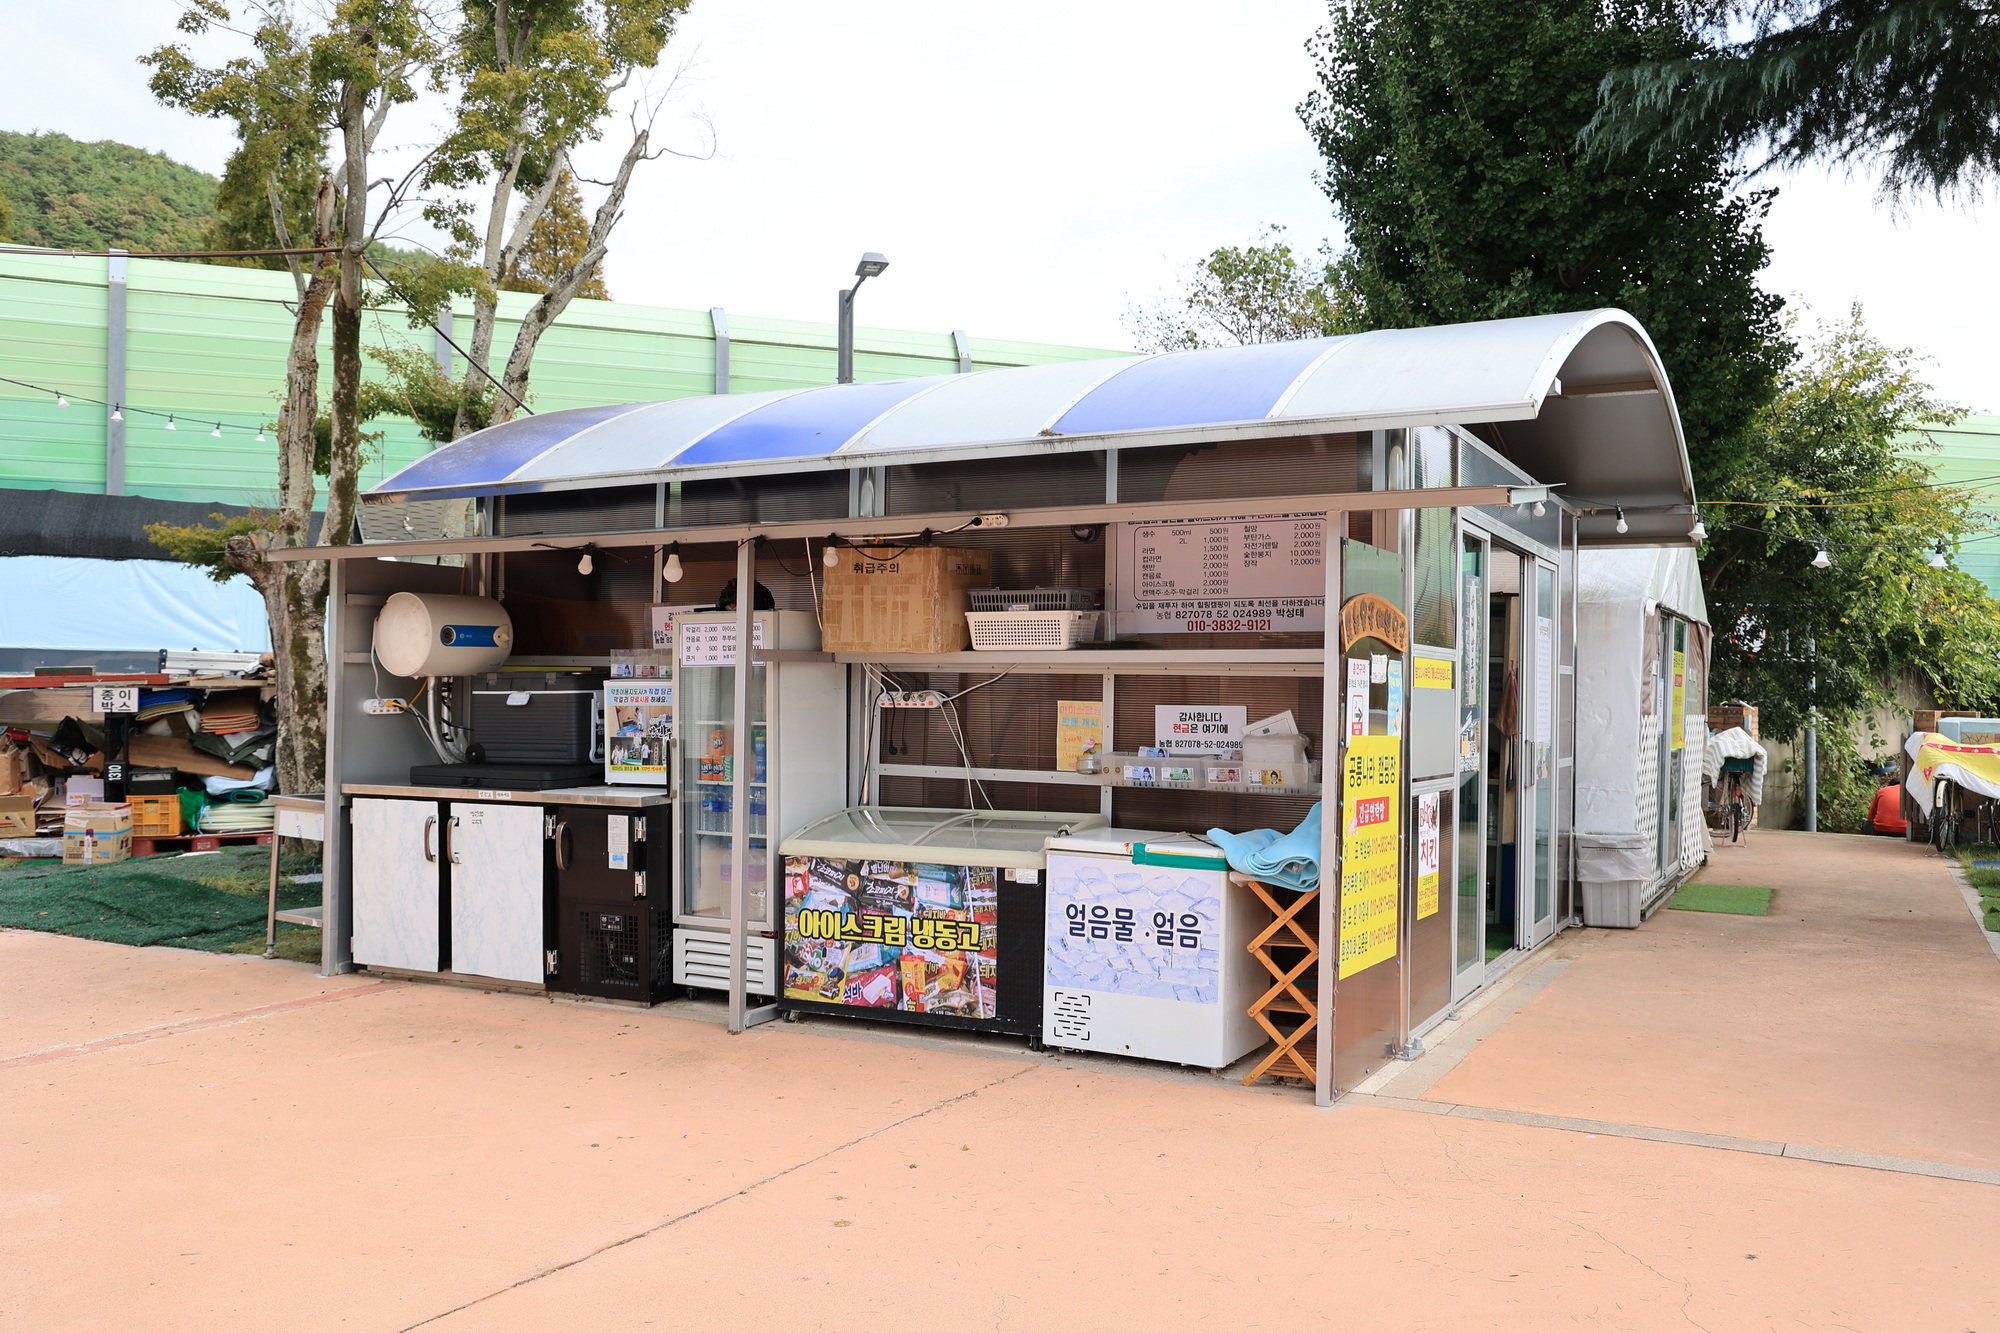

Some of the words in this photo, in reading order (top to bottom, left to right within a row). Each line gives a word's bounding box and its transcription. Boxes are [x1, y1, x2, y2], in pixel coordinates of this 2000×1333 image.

[1142, 530, 1155, 538] 생수
[1209, 527, 1228, 535] 500원
[1294, 523, 1321, 531] 2,000원
[1203, 536, 1228, 544] 1,000원
[1243, 533, 1271, 541] 부탄가스
[1294, 531, 1321, 539] 2,000원
[1294, 540, 1321, 548] 2,000원
[1142, 555, 1162, 563] 컵라면
[1203, 553, 1228, 561] 2,000원
[1290, 549, 1321, 557] 10,000원
[1203, 562, 1228, 570] 2,000원
[1290, 558, 1321, 566] 12,000원
[853, 562, 899, 574] 취급주의
[1142, 580, 1175, 588] 아이스크림
[1203, 579, 1228, 587] 2,000원
[1135, 602, 1155, 610] 수입을
[1181, 601, 1195, 609] 하여
[1197, 601, 1231, 609] 힐링캠핑이
[1234, 600, 1255, 608] 되도록
[1282, 599, 1325, 607] 다하겠습니다
[1156, 611, 1172, 620] 농협
[1175, 610, 1213, 619] 827078
[1216, 610, 1229, 618] 52
[1232, 609, 1272, 618] 024989
[1275, 608, 1305, 618] 박성태
[1187, 619, 1271, 632] 010-3832-9121
[101, 701, 131, 713] 박스
[1060, 705, 1101, 715] 아이스크림
[1178, 712, 1222, 723] 감사합니다
[1173, 723, 1199, 734] 현금은
[1202, 723, 1229, 734] 여기에
[1159, 740, 1173, 748] 농협
[1175, 740, 1243, 748] 827078-52-024989
[108, 765, 122, 781] 1310
[1349, 756, 1375, 787] 공룡나라
[1378, 755, 1396, 784] 캠핑장
[1359, 800, 1386, 824] 긴급연락망
[1421, 837, 1437, 868] 치킨
[1066, 903, 1136, 942] 얼음물
[799, 909, 907, 947] 아이스크림
[911, 918, 981, 951] 냉동고
